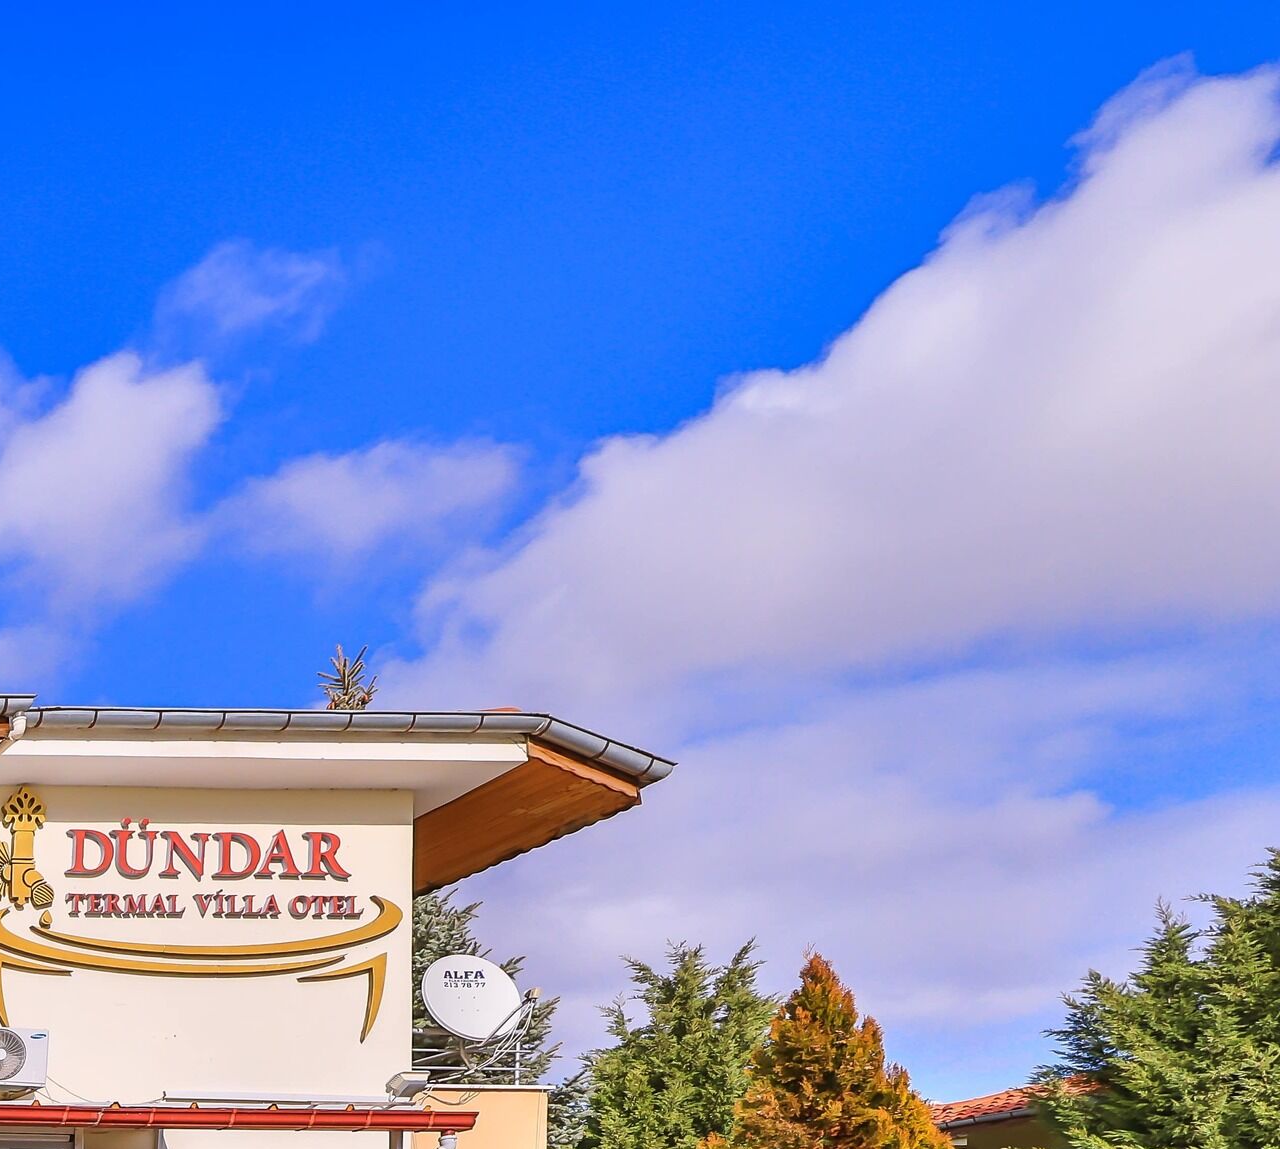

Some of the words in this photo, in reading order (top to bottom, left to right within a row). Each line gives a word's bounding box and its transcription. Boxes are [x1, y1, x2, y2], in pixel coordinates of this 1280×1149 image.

[64, 818, 351, 882] DÜNDAR
[65, 893, 185, 918] TERMAL
[288, 895, 365, 920] OTEL
[444, 970, 485, 979] ALFA
